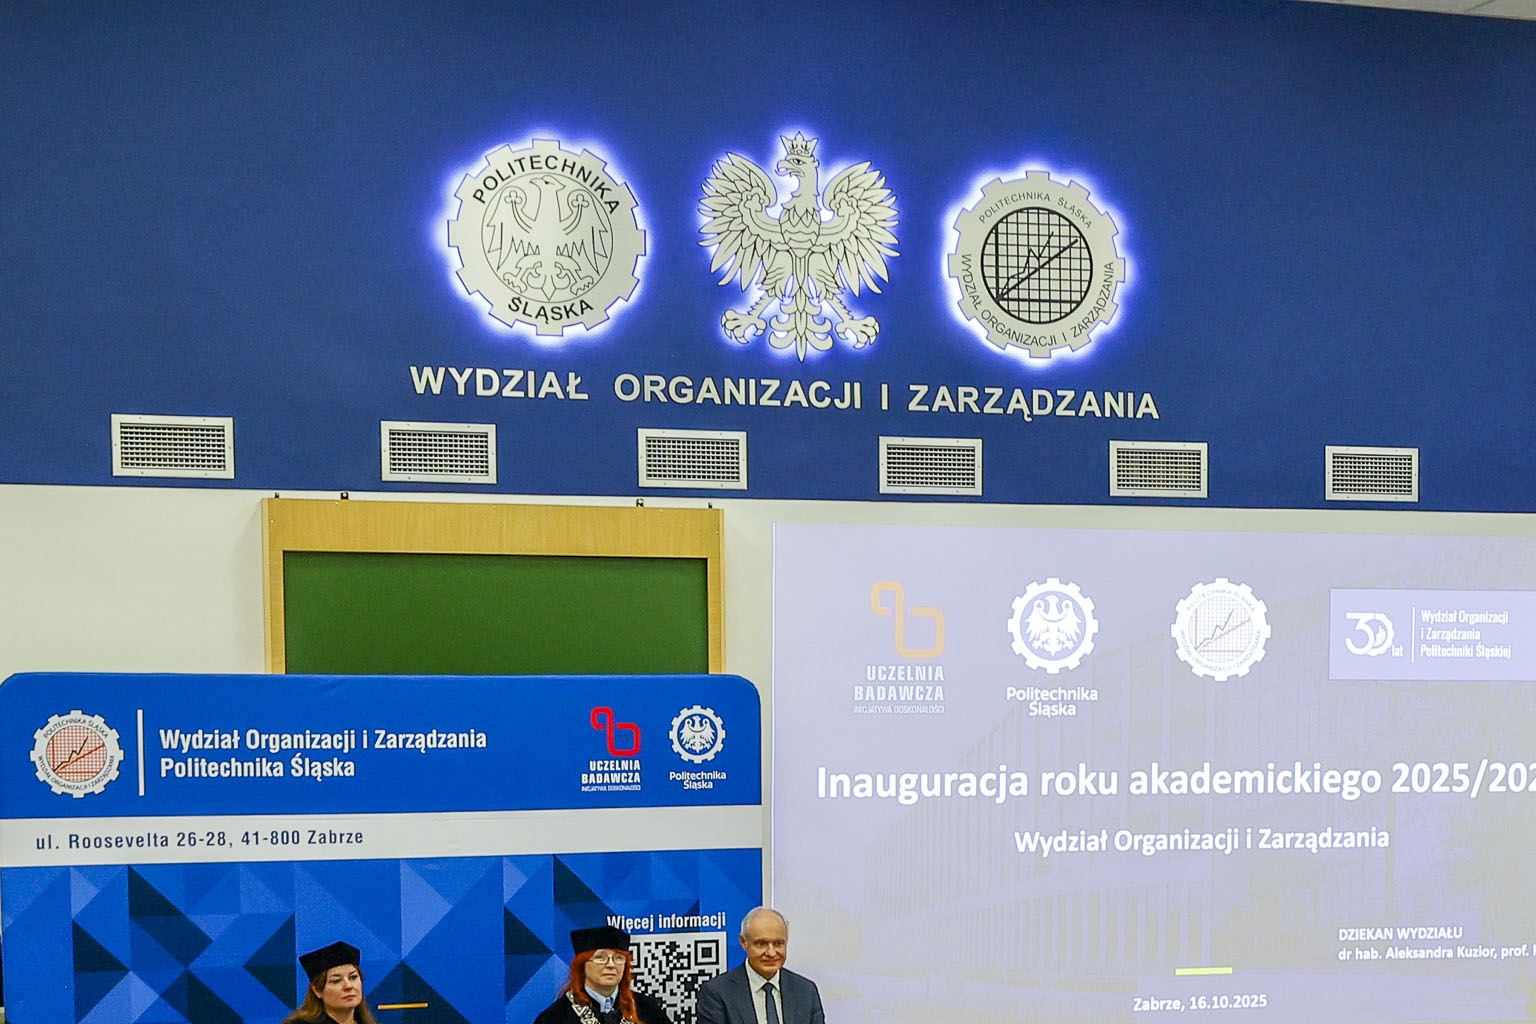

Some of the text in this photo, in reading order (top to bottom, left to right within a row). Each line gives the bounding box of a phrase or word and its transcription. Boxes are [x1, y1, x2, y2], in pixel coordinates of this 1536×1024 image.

[472, 154, 620, 214] POLITECHNIKA
[979, 191, 1092, 228] POLITECHNIKA ŚLĄSKA
[962, 253, 983, 311] WYDZIAŁ
[981, 309, 1057, 347] ORGANIZACJI
[1070, 261, 1114, 338] ZARZĄDZANIA
[508, 296, 594, 324] ŚLĄSKA
[409, 366, 1160, 422] WYDZIAŁ ORGANIZACJI I ZARZĄDZANIA
[1421, 609, 1509, 625] Wydział Organizacji
[1345, 612, 1395, 657] 30
[1426, 628, 1480, 643] Zarządzania
[1391, 645, 1404, 657] lat
[1420, 641, 1512, 660] Politechniki Śląskiej
[866, 665, 945, 681] UCZELNIA
[854, 685, 945, 701] BADAWCZA
[1006, 686, 1099, 704] Politechnika
[1029, 699, 1077, 719] Śląska
[159, 729, 487, 757] Wydział Organizacji i Zarządzania
[160, 752, 356, 782] Politechnika Śląska
[589, 760, 641, 771] UCZELNIA
[581, 773, 641, 784] BADAWCZA
[669, 771, 727, 781] Politechnika
[683, 779, 713, 791] Śląska
[817, 765, 1029, 805] Inauguracja
[1040, 762, 1118, 796] roku
[1129, 761, 1382, 801] akademickiego
[36, 830, 364, 850] ul. Roosevelta 26-28, 41-800 Zabrze
[1014, 826, 1390, 858] Wydział Organizacji i Zarządzania
[607, 911, 727, 933] Więcej informacji
[1338, 926, 1463, 941] DZIEKAN WYDZIAŁU
[1338, 948, 1353, 960] dr
[1355, 947, 1382, 960] hab.
[1385, 945, 1454, 959] Aleksandra
[1457, 945, 1498, 959] Kuzior,
[1501, 943, 1530, 958] prof.
[1133, 994, 1268, 1012] Zabrze, 16.10.2025
